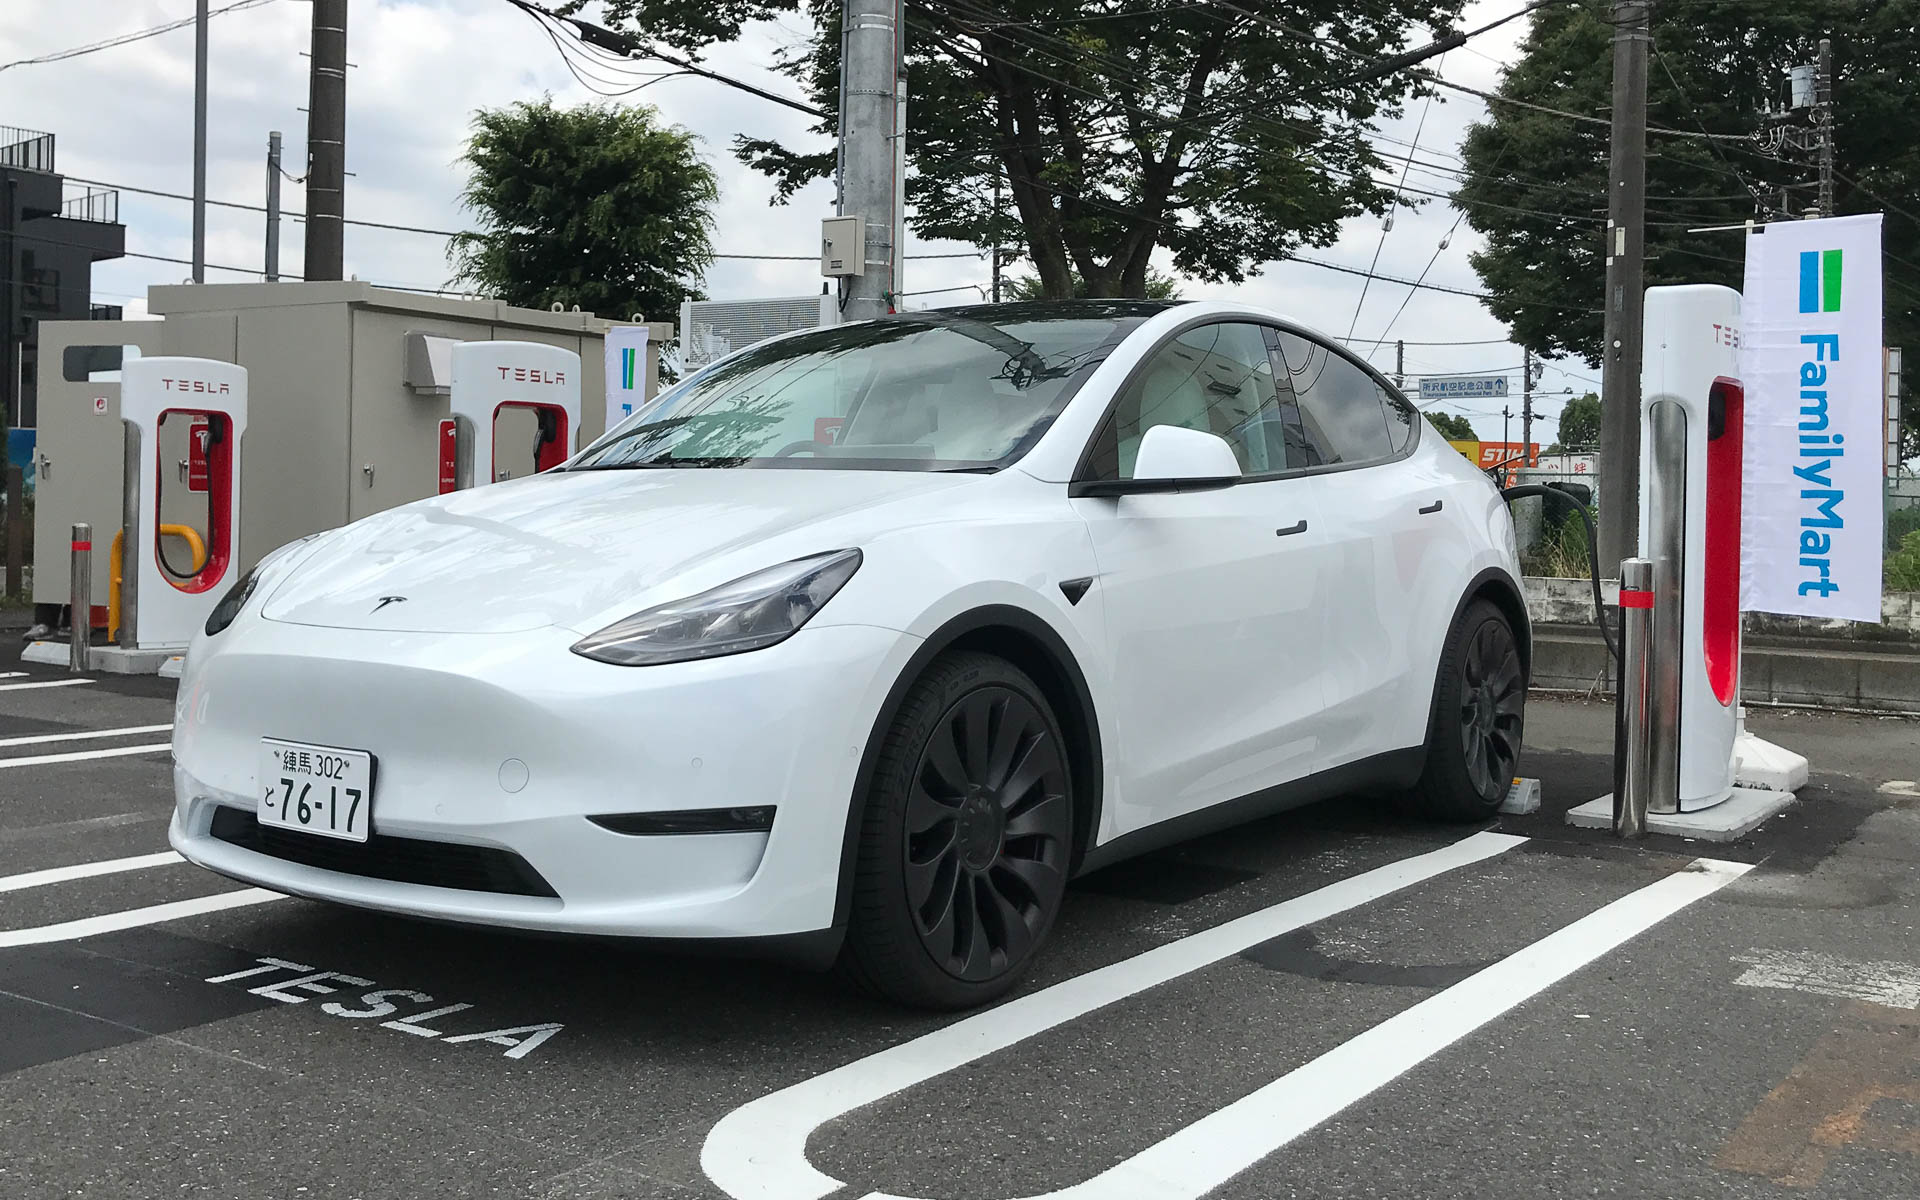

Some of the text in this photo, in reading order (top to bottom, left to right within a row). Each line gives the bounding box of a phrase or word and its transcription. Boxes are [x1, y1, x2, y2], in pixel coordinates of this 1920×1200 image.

[1712, 323, 1741, 349] TES
[162, 379, 230, 395] TESLA
[497, 366, 565, 385] TESLA
[1793, 334, 1844, 598] FamilyMart
[282, 749, 343, 780] 練馬 302
[264, 777, 362, 833] と 76-17
[204, 956, 566, 1060] TESLA
